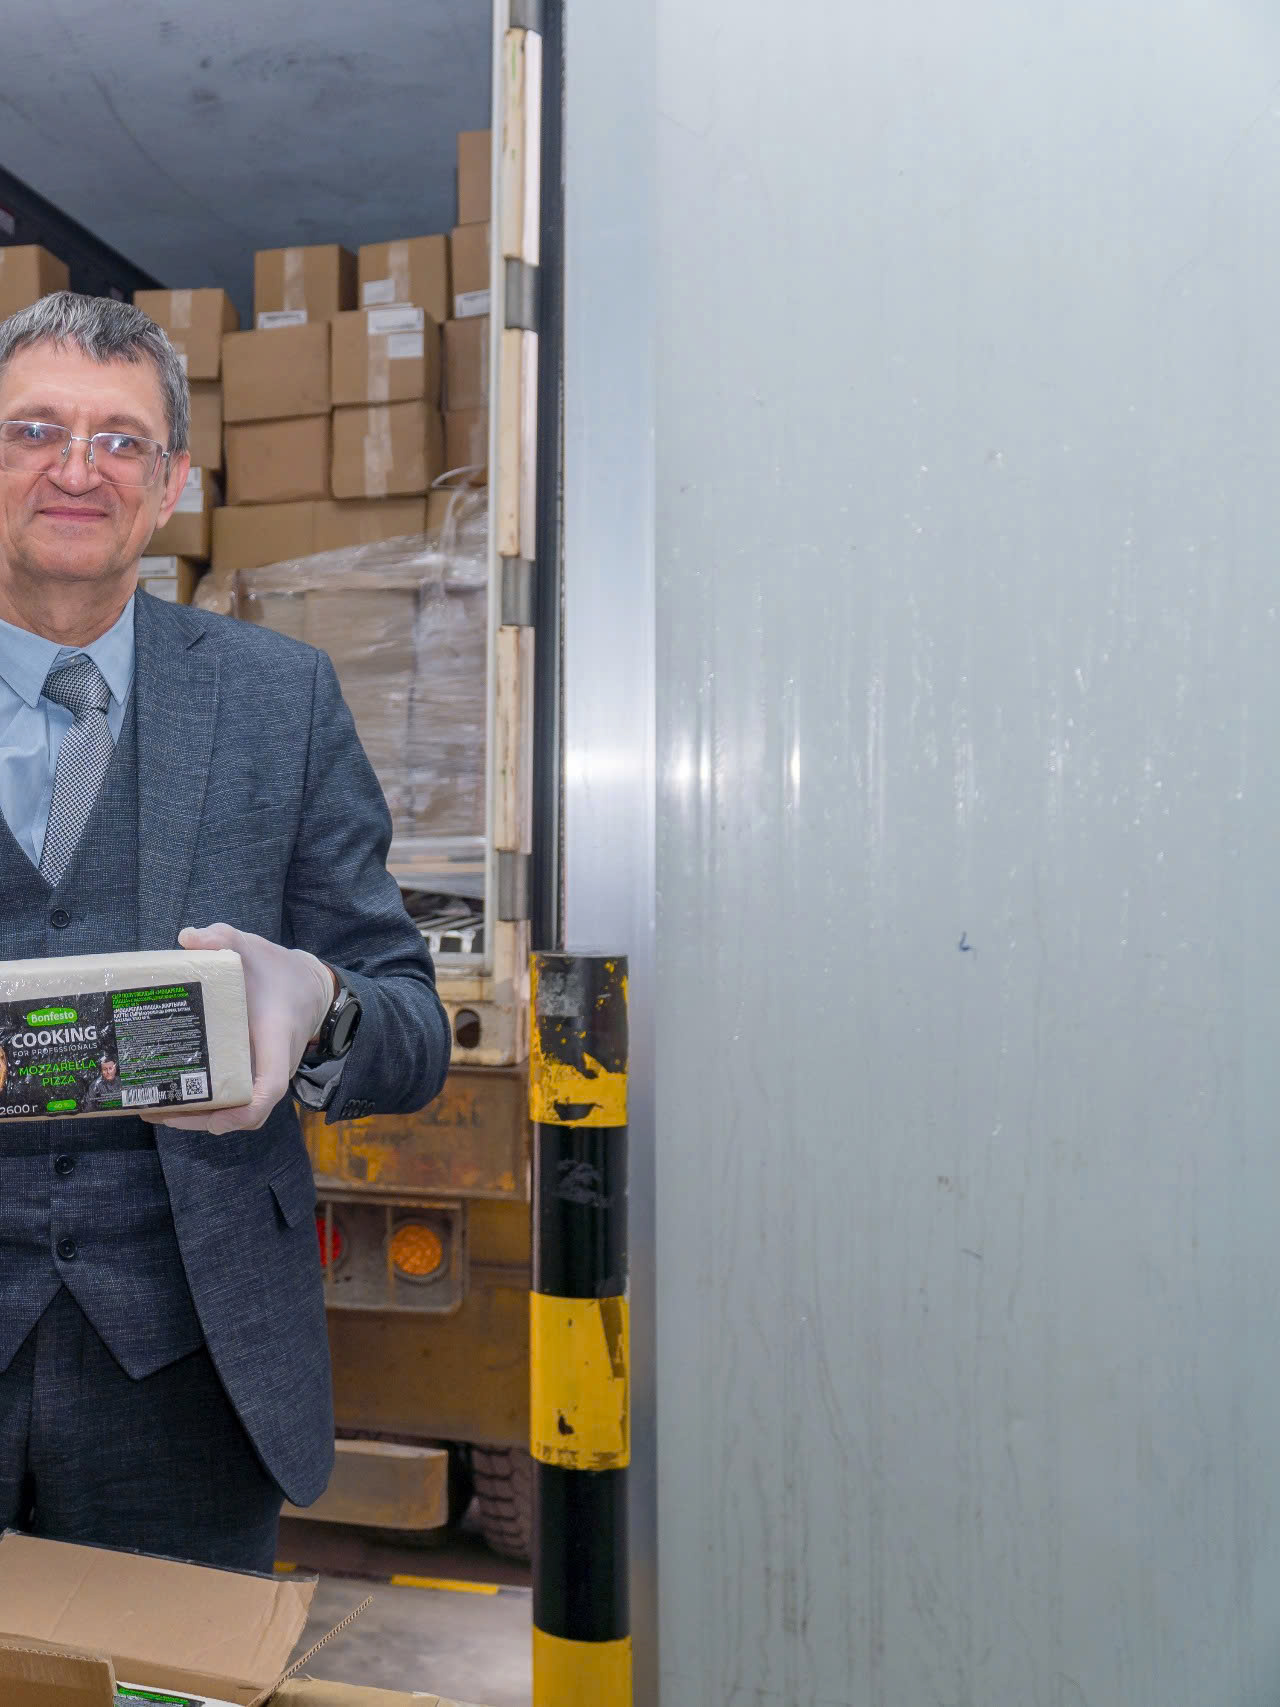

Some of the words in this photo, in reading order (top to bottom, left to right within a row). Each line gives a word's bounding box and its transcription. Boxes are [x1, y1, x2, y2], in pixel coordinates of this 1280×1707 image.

[31, 1011, 75, 1024] Bonfesto
[12, 1026, 98, 1048] COOKING
[13, 1050, 29, 1058] FOR
[32, 1043, 98, 1056] PROFESSIONALS
[19, 1059, 97, 1076] MOZZARELLA
[42, 1075, 76, 1087] PIZZA
[0, 1104, 30, 1116] 2600
